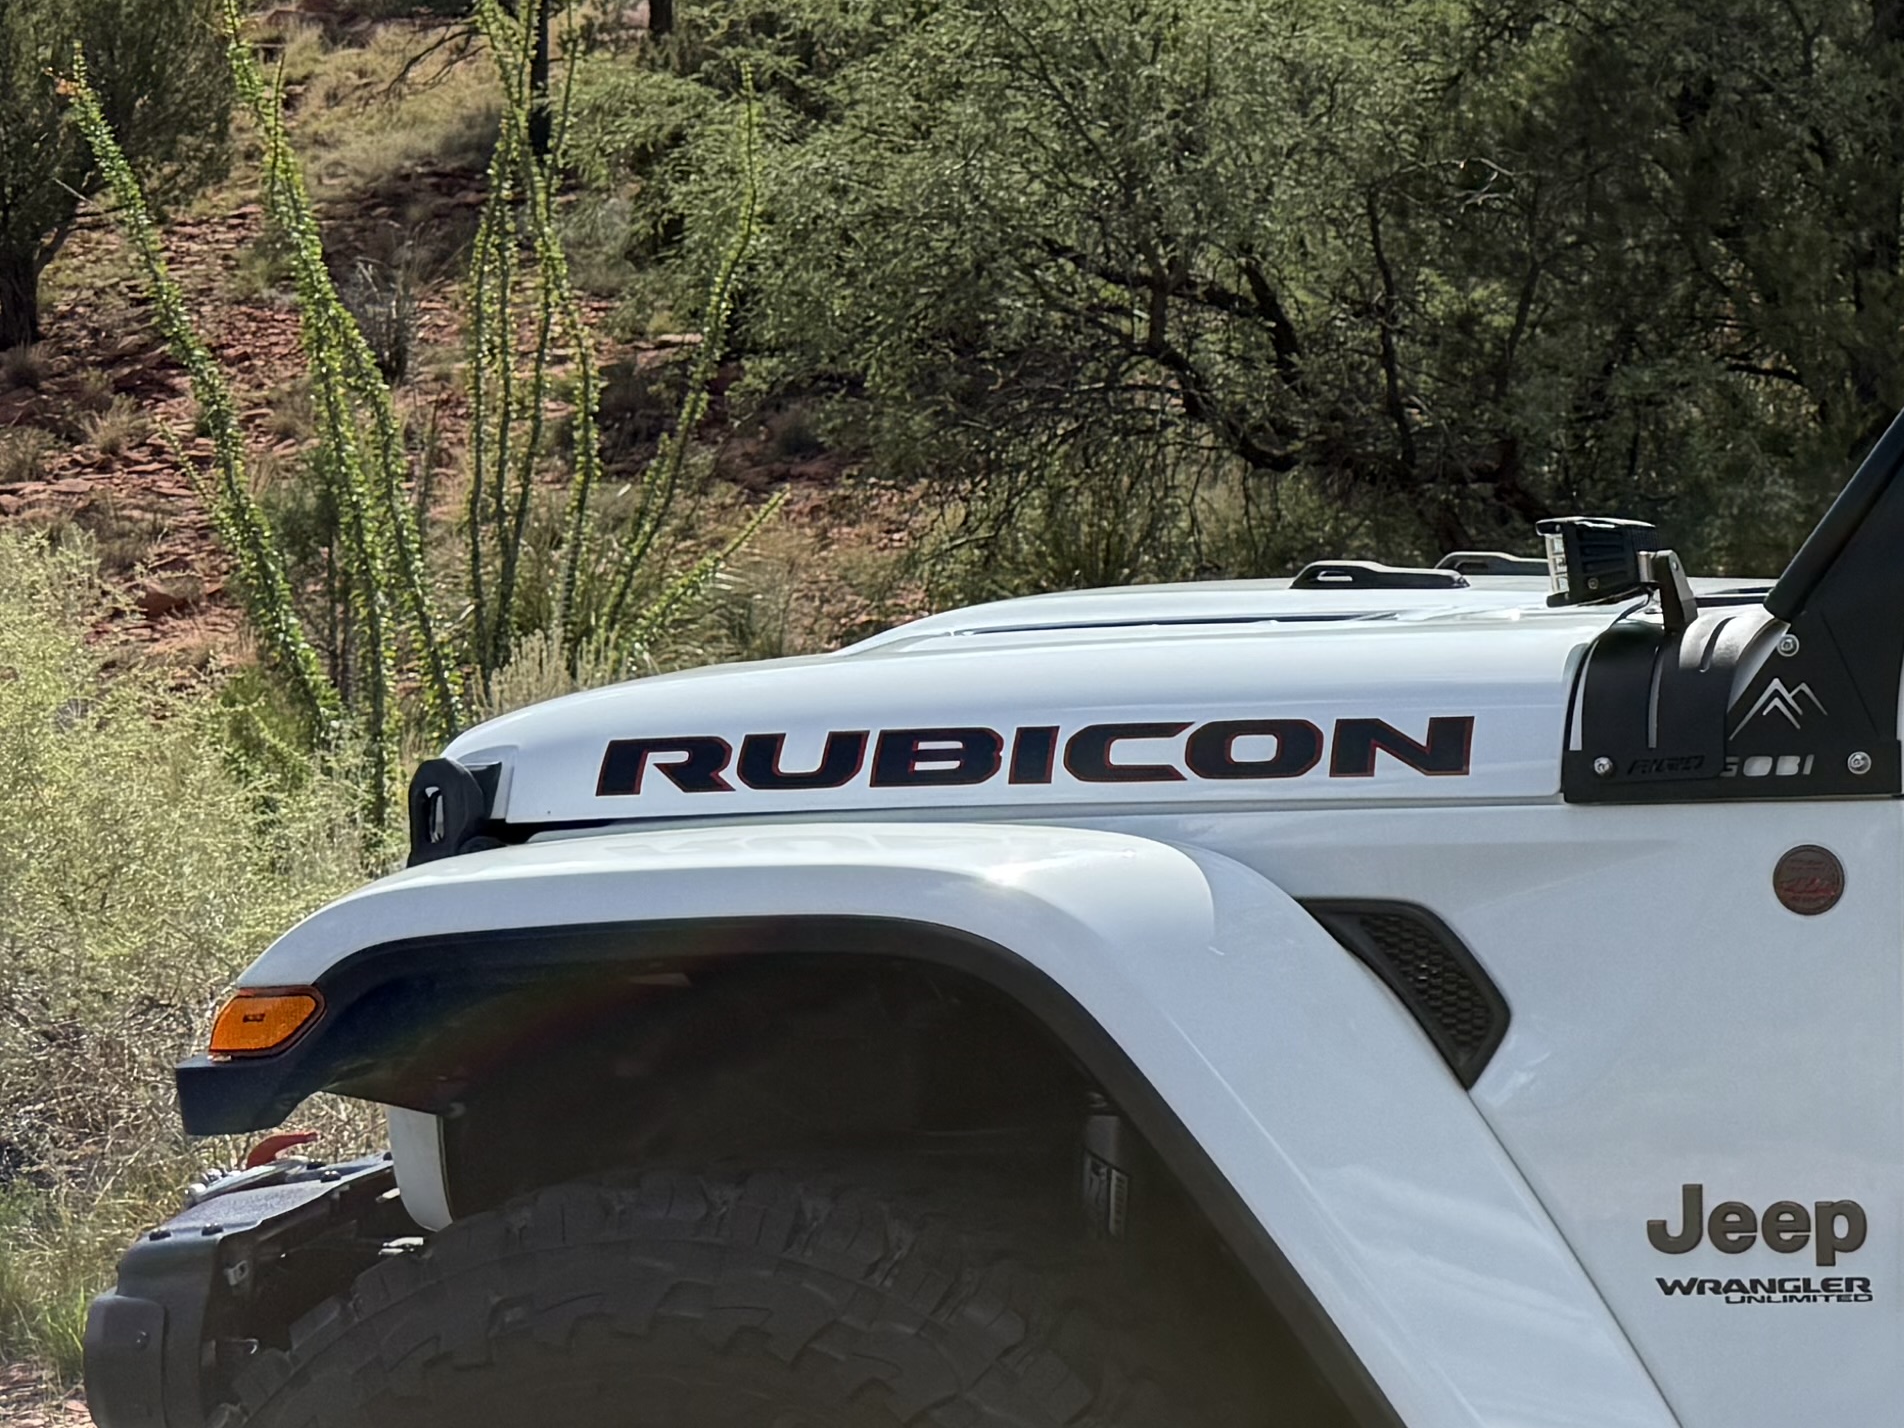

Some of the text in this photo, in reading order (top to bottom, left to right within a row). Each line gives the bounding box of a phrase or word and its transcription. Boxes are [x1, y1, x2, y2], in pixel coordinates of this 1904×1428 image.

[594, 714, 1476, 797] RUBICON
[1646, 1183, 1868, 1267] Jeep
[1654, 1276, 1873, 1297] WRANGLER
[1724, 1293, 1874, 1305] UNLIMITED
